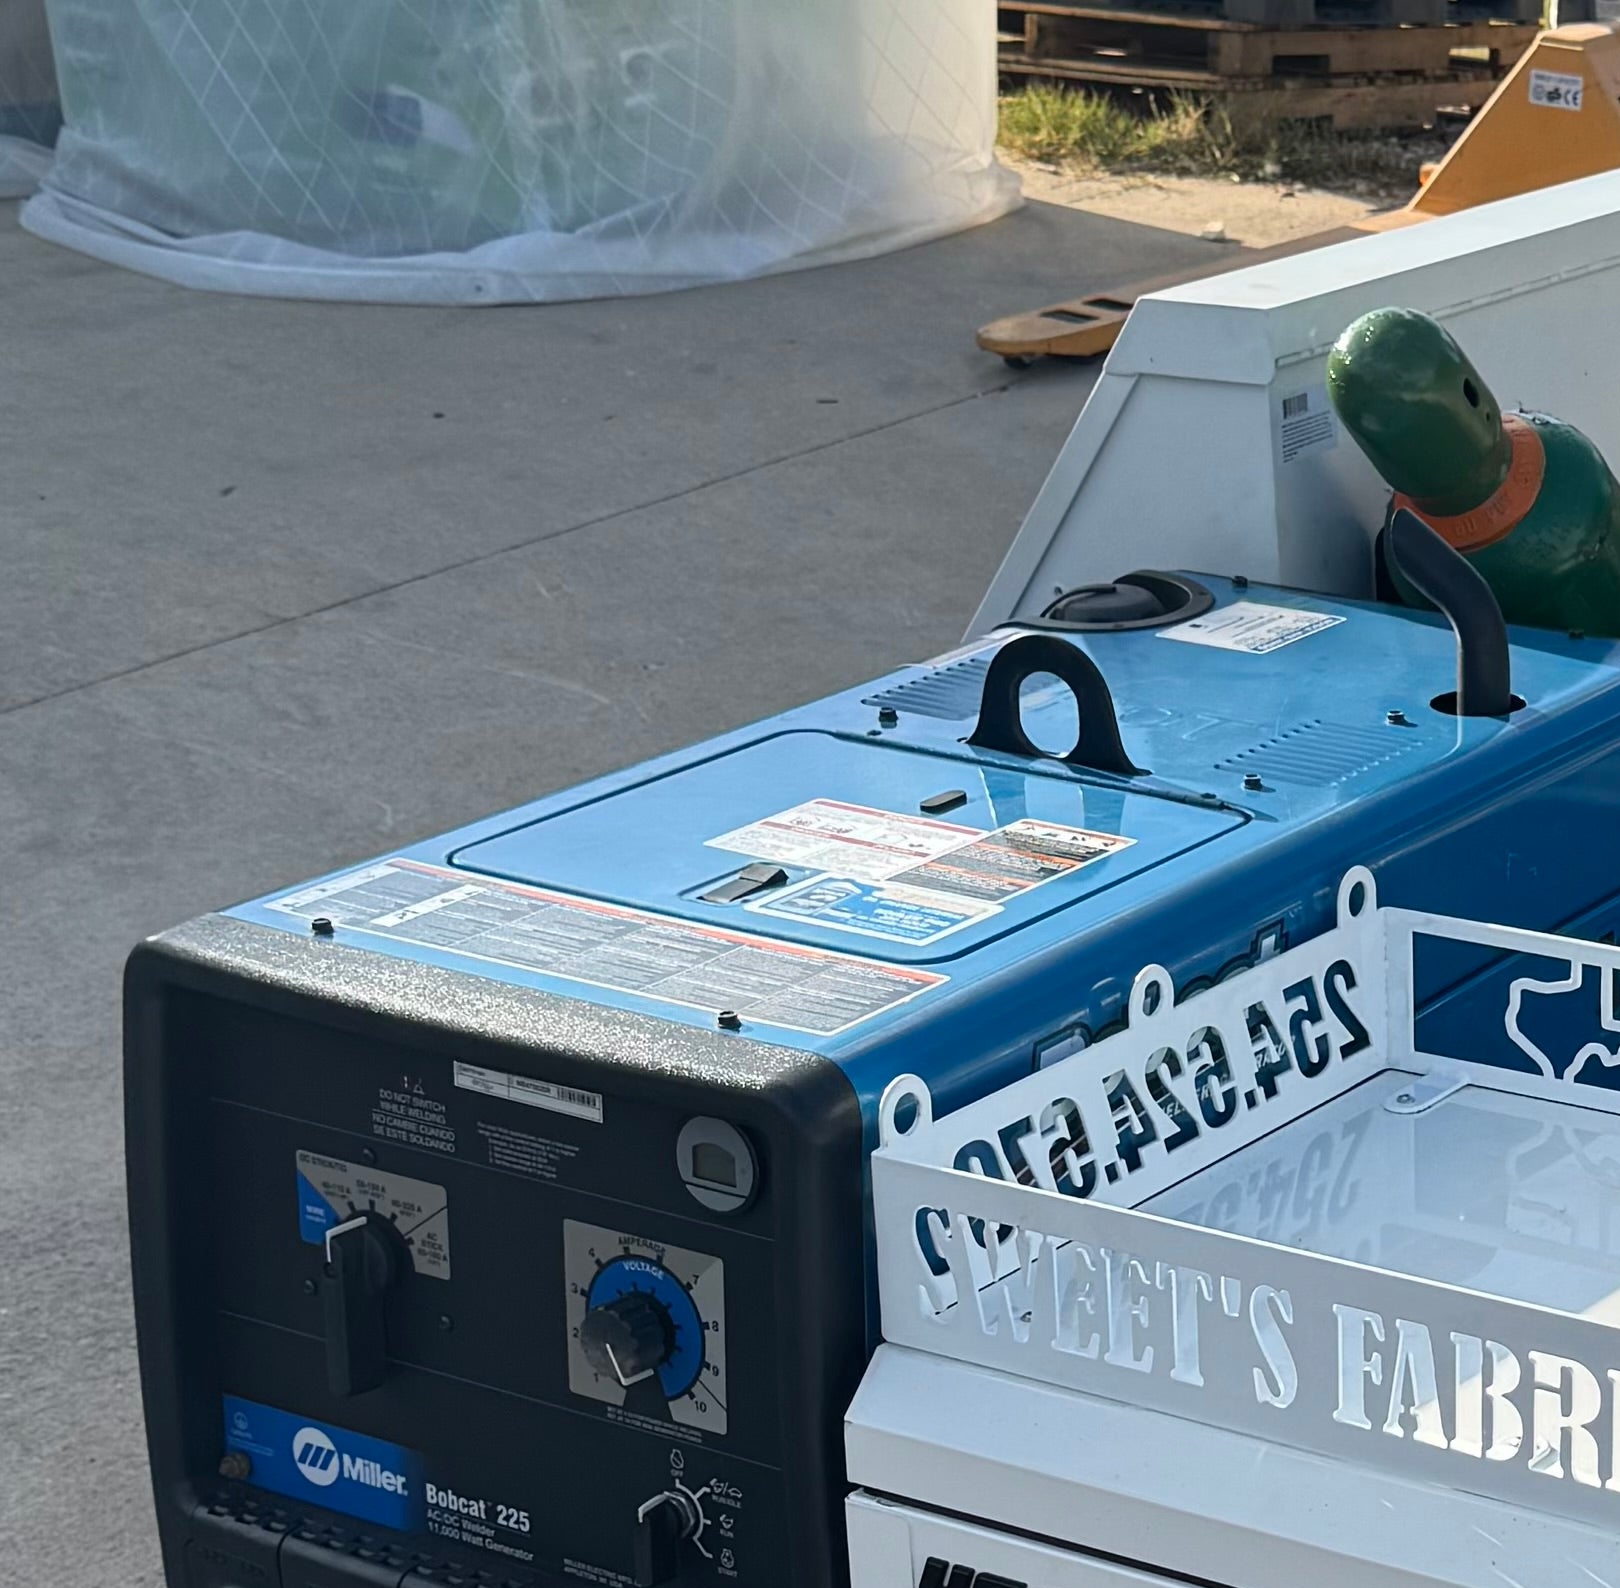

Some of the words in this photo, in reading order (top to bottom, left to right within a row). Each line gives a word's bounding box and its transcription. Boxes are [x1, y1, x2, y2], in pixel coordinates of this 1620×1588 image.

[622, 1260, 664, 1280] VOLTAGE
[912, 1204, 1297, 1410] SWEET'S
[573, 1327, 580, 1338] 2
[711, 1320, 719, 1331] 8
[711, 1366, 719, 1377] 9
[694, 1400, 707, 1413] 10
[425, 1482, 487, 1520] Bobcat
[496, 1504, 530, 1532] 225
[461, 1516, 495, 1538] Welder
[427, 1521, 460, 1541] 11,000
[461, 1531, 484, 1548] Watt
[484, 1536, 534, 1563] Generator
